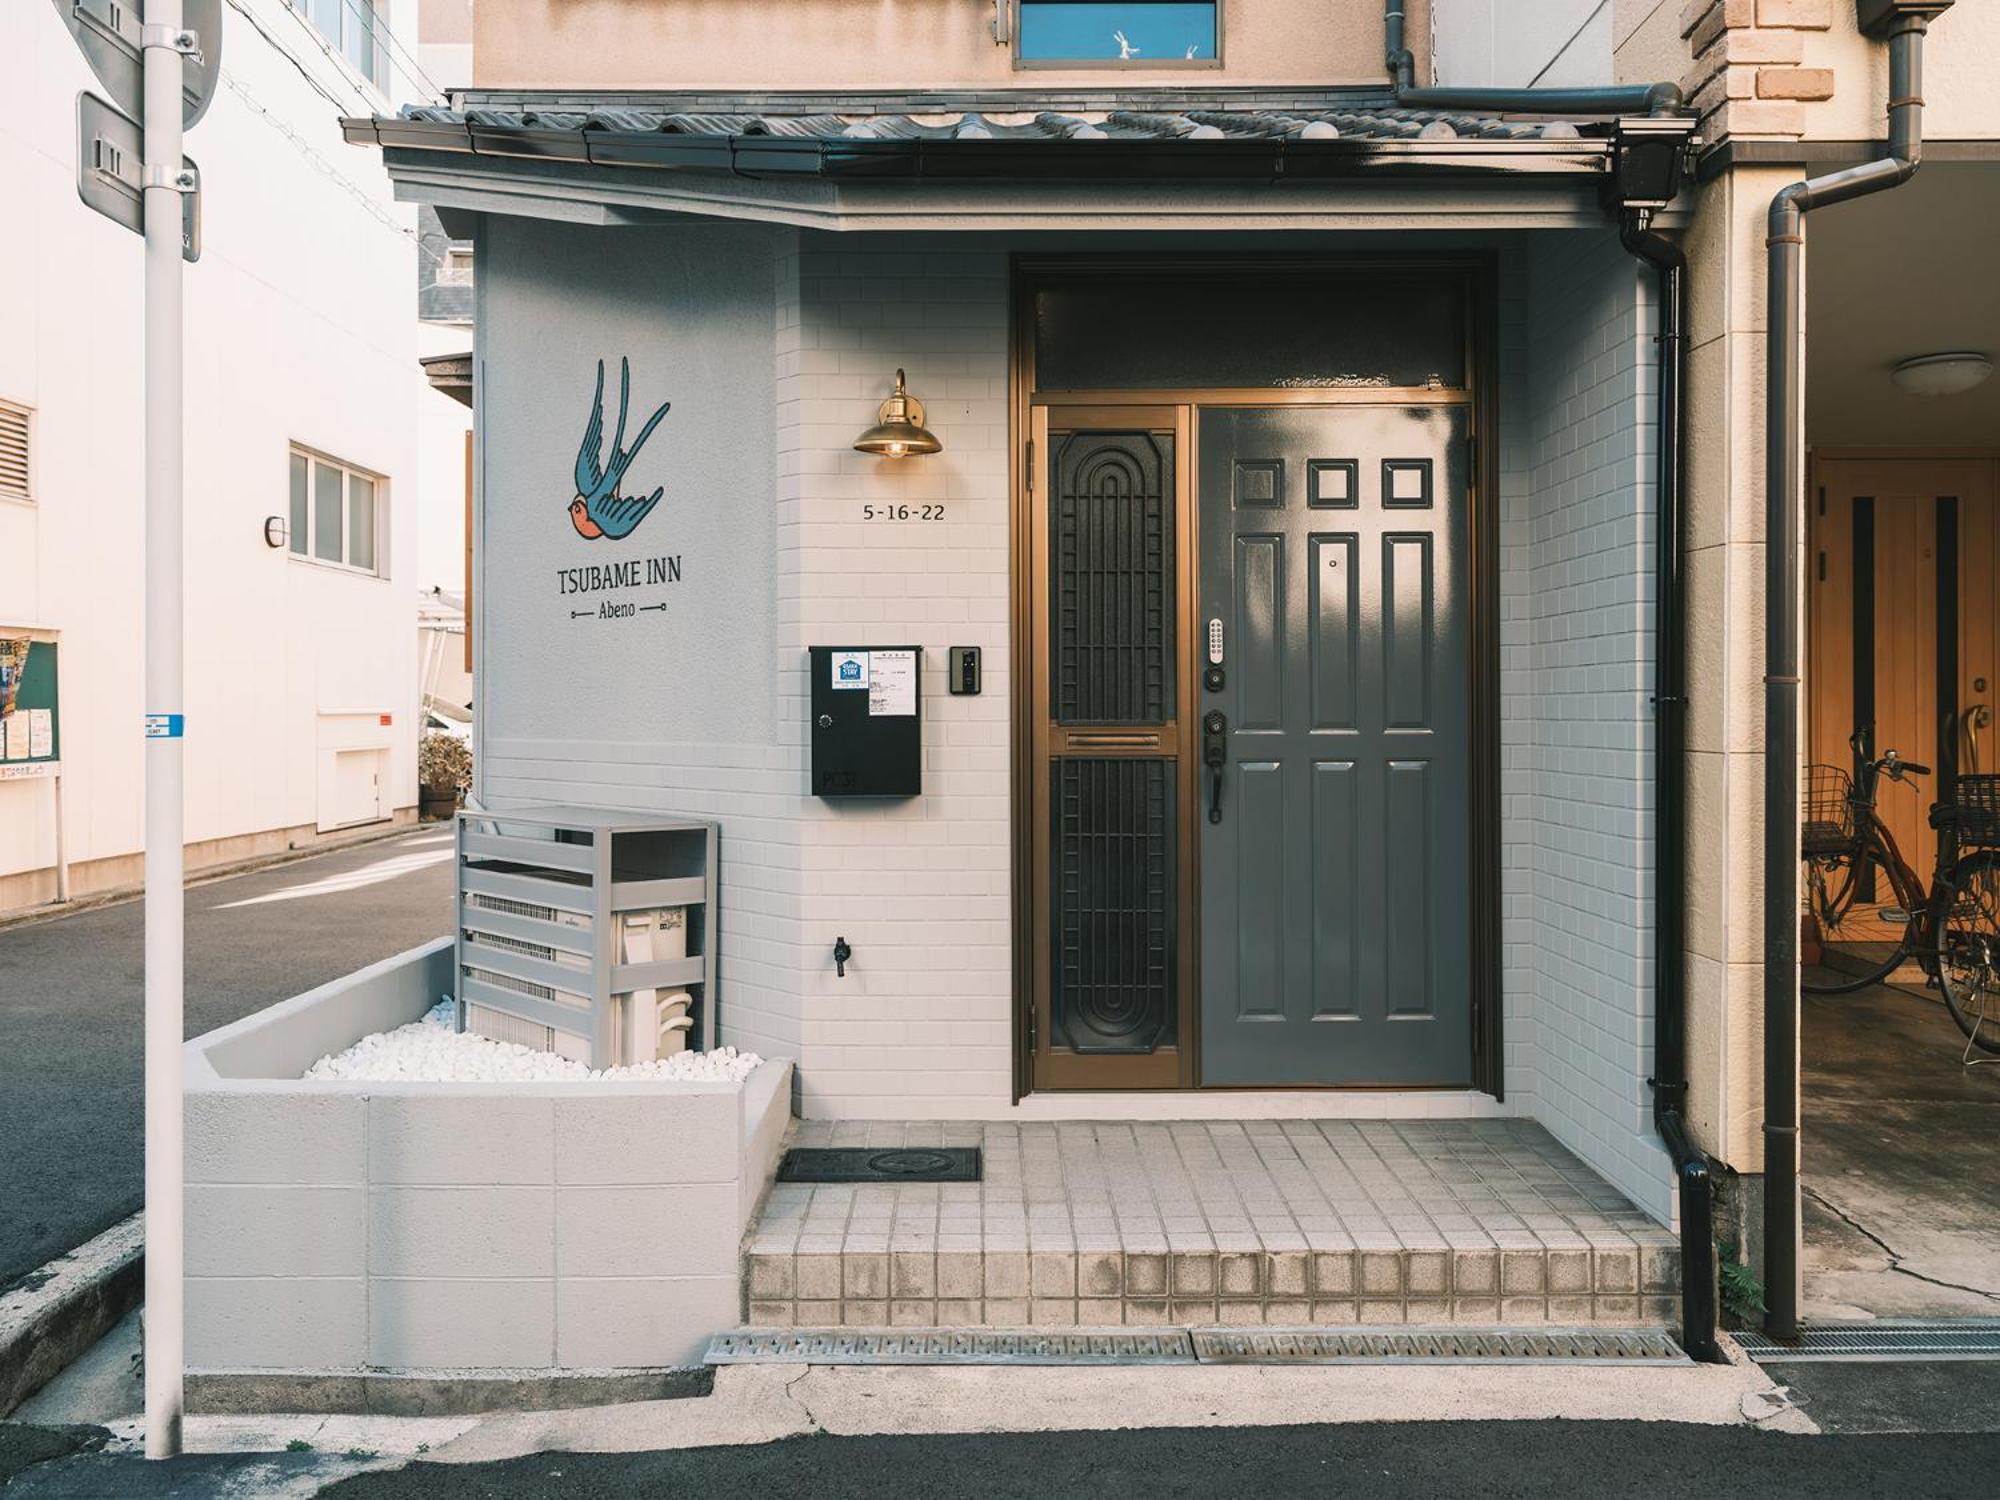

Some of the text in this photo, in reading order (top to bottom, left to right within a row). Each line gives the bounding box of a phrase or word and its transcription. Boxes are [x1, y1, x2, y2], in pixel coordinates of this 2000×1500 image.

[864, 504, 945, 521] 5-16-22
[557, 555, 682, 594] TSUBAME INN
[598, 600, 635, 619] Abeno
